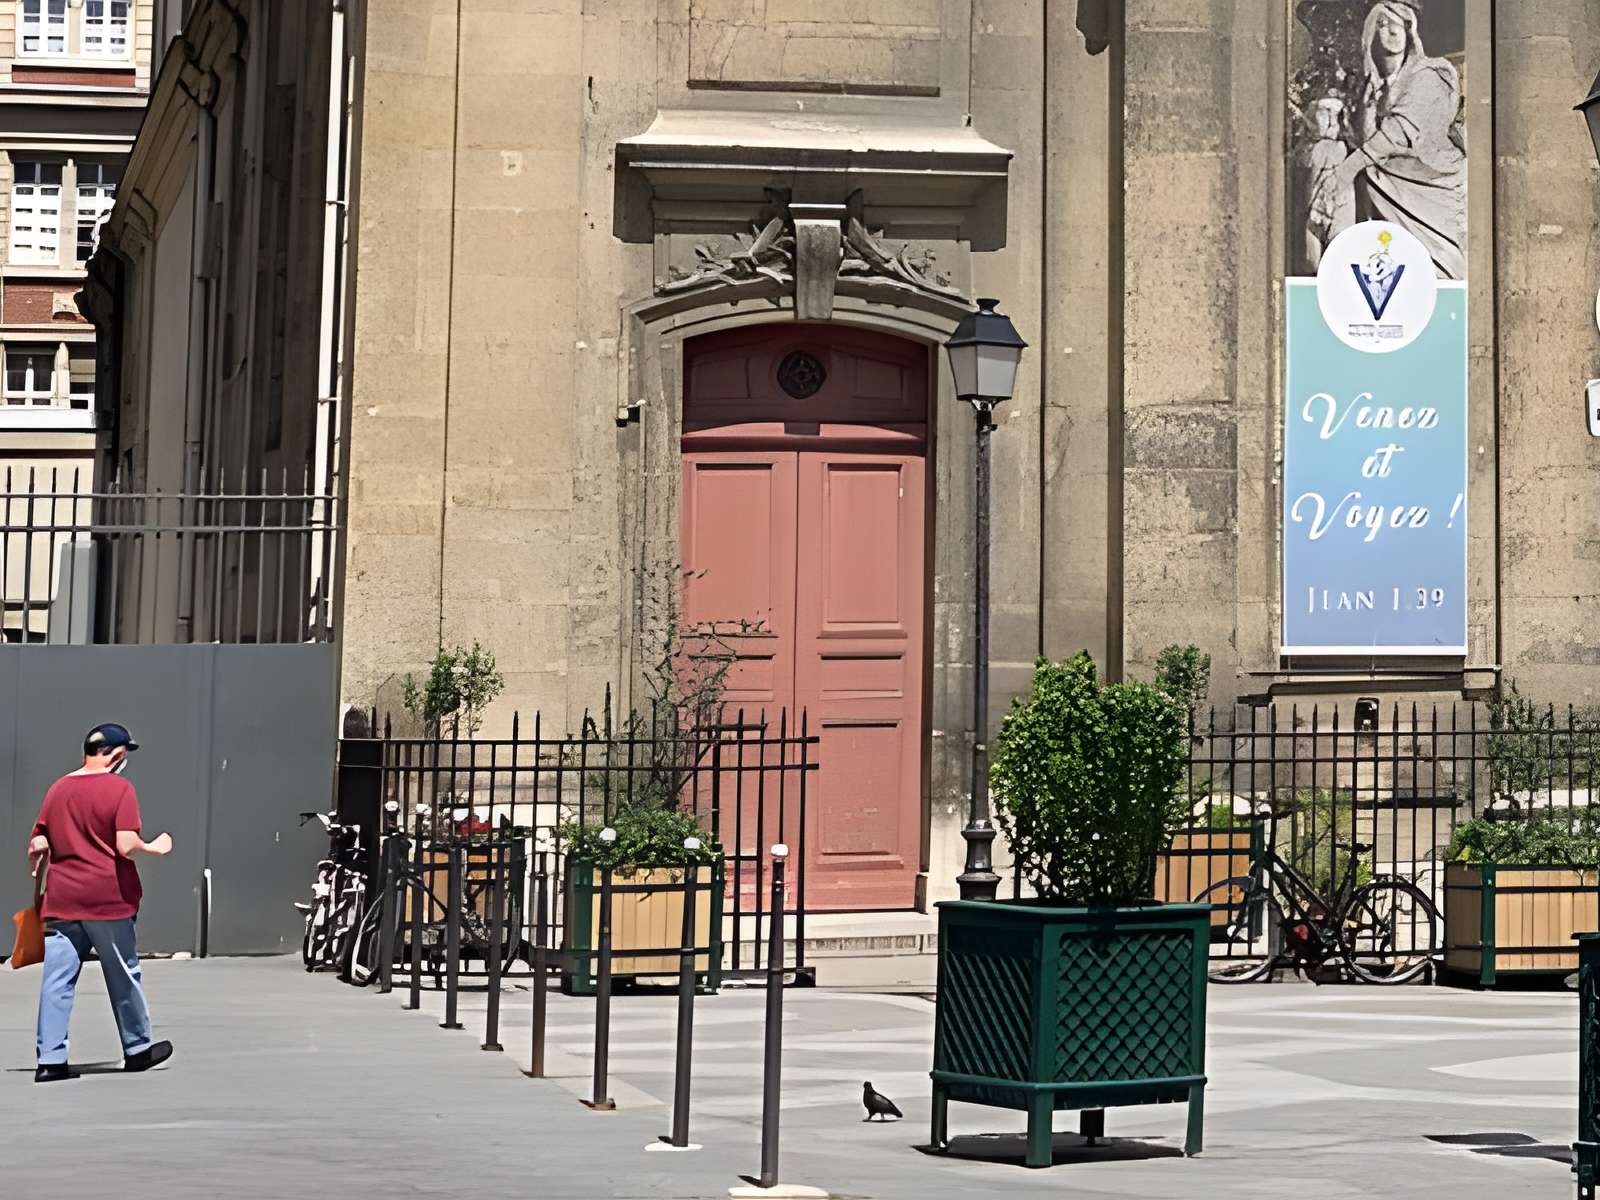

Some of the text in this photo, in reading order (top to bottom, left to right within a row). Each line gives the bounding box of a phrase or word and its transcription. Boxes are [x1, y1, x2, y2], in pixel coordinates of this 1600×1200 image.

[1302, 392, 1440, 440] Venez
[1361, 443, 1405, 478] et
[1291, 492, 1431, 543] Voyez
